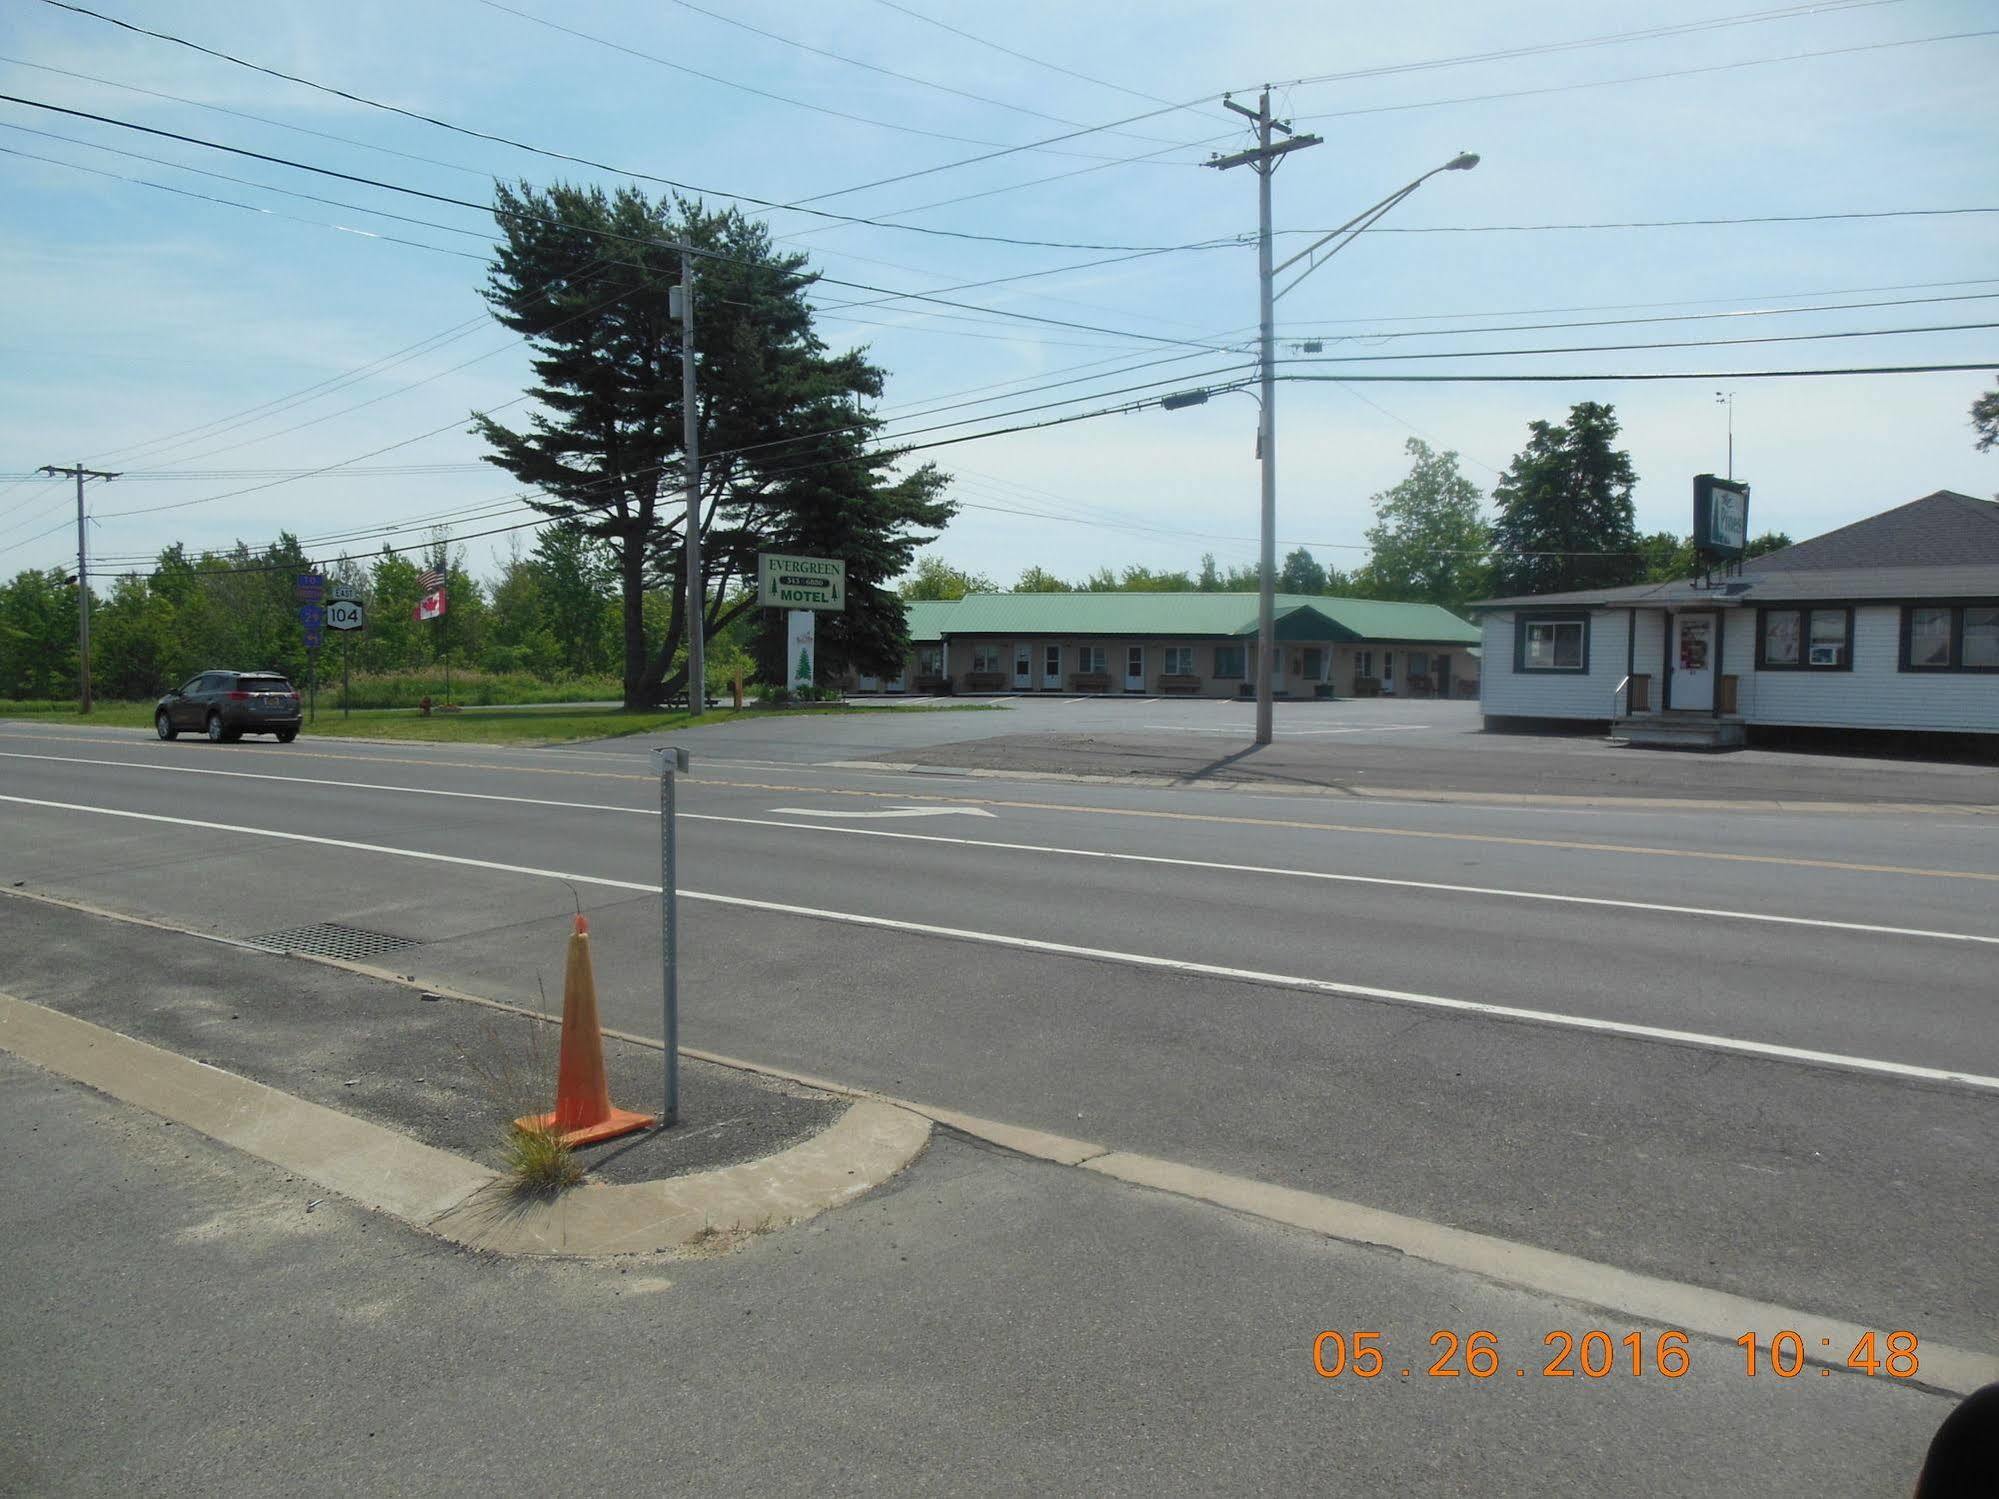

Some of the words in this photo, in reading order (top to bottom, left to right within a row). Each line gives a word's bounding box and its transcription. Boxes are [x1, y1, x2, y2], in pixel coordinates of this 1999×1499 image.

[769, 559, 840, 575] EVERGREEN
[335, 588, 352, 598] EAST
[781, 589, 829, 603] MOTEL
[331, 608, 358, 623] 104
